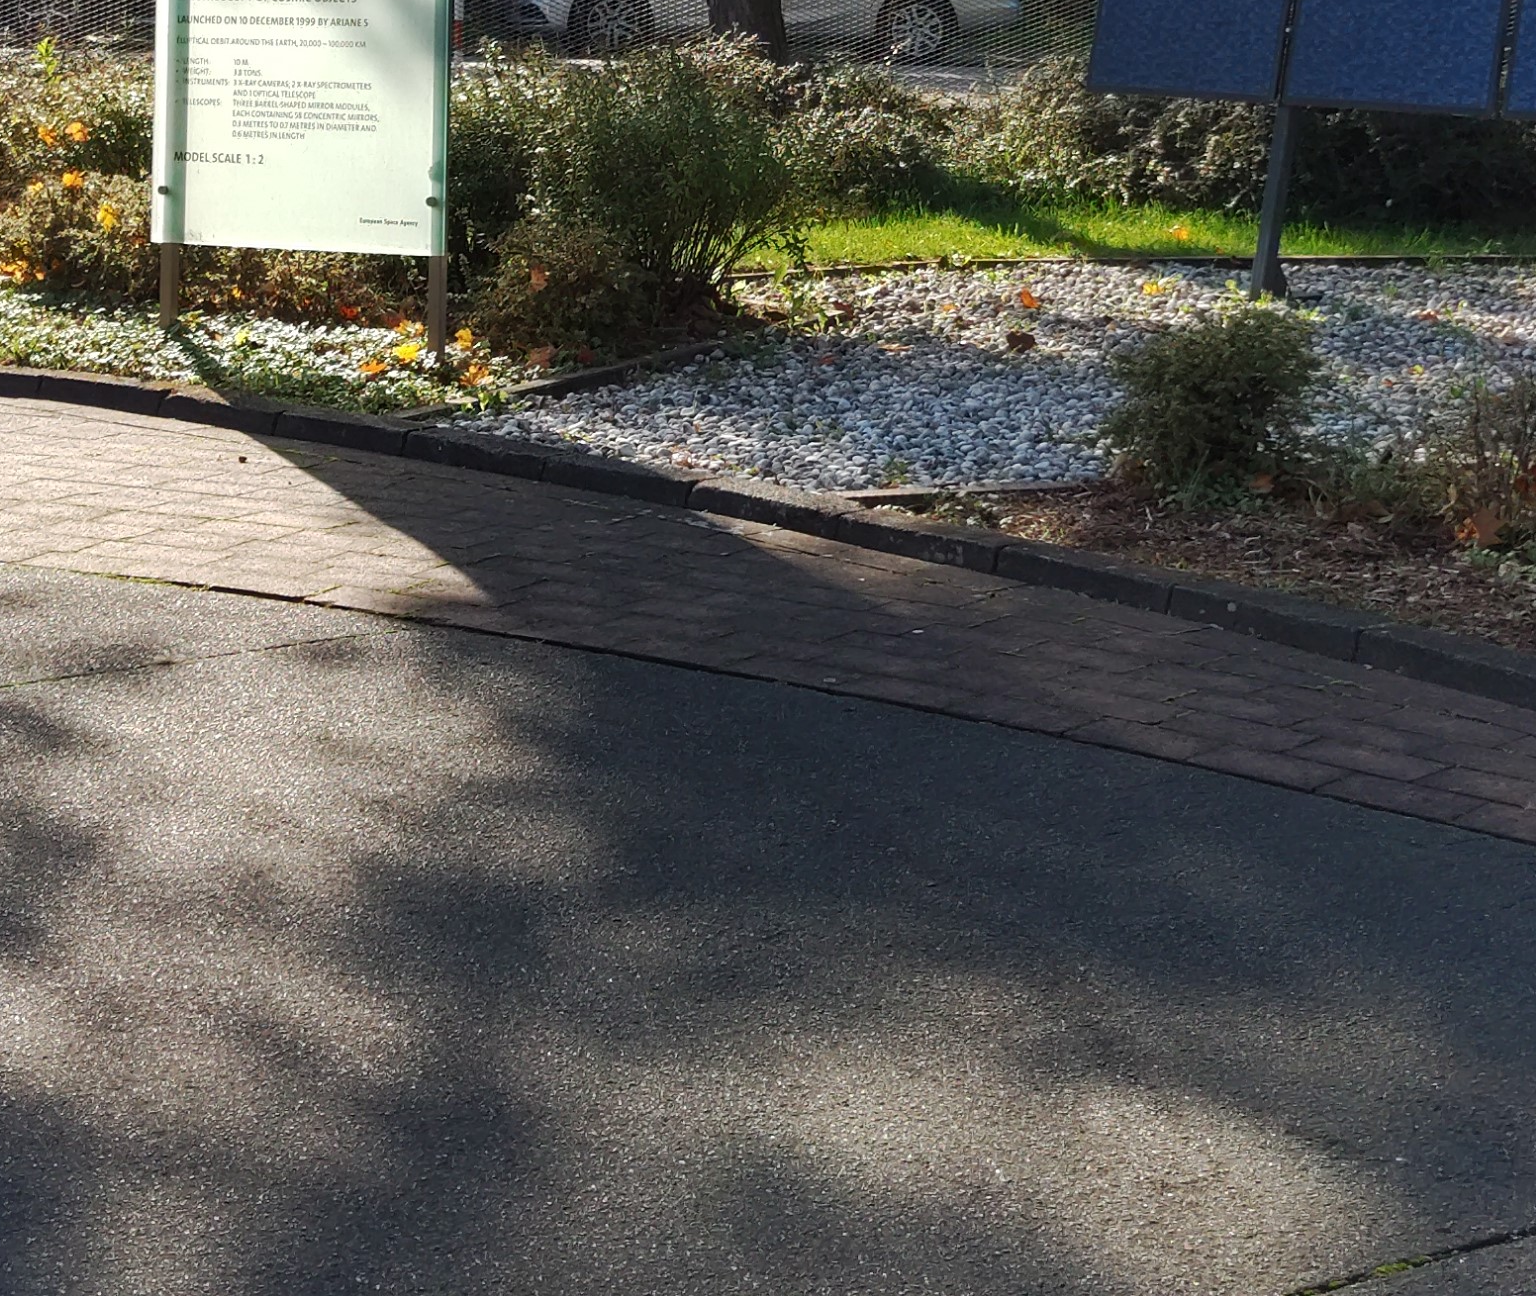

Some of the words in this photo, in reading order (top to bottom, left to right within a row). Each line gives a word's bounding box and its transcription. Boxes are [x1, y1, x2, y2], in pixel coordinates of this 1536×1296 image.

[177, 15, 222, 25] LAUNCHED
[224, 16, 238, 25] ON
[238, 16, 248, 25] 10
[250, 16, 294, 26] DECEMBER
[296, 16, 316, 26] 1999
[318, 17, 328, 26] BY
[330, 18, 362, 27] ARIANE
[233, 89, 248, 97] AND
[174, 152, 210, 162] MODEL
[212, 153, 242, 164] SCALE
